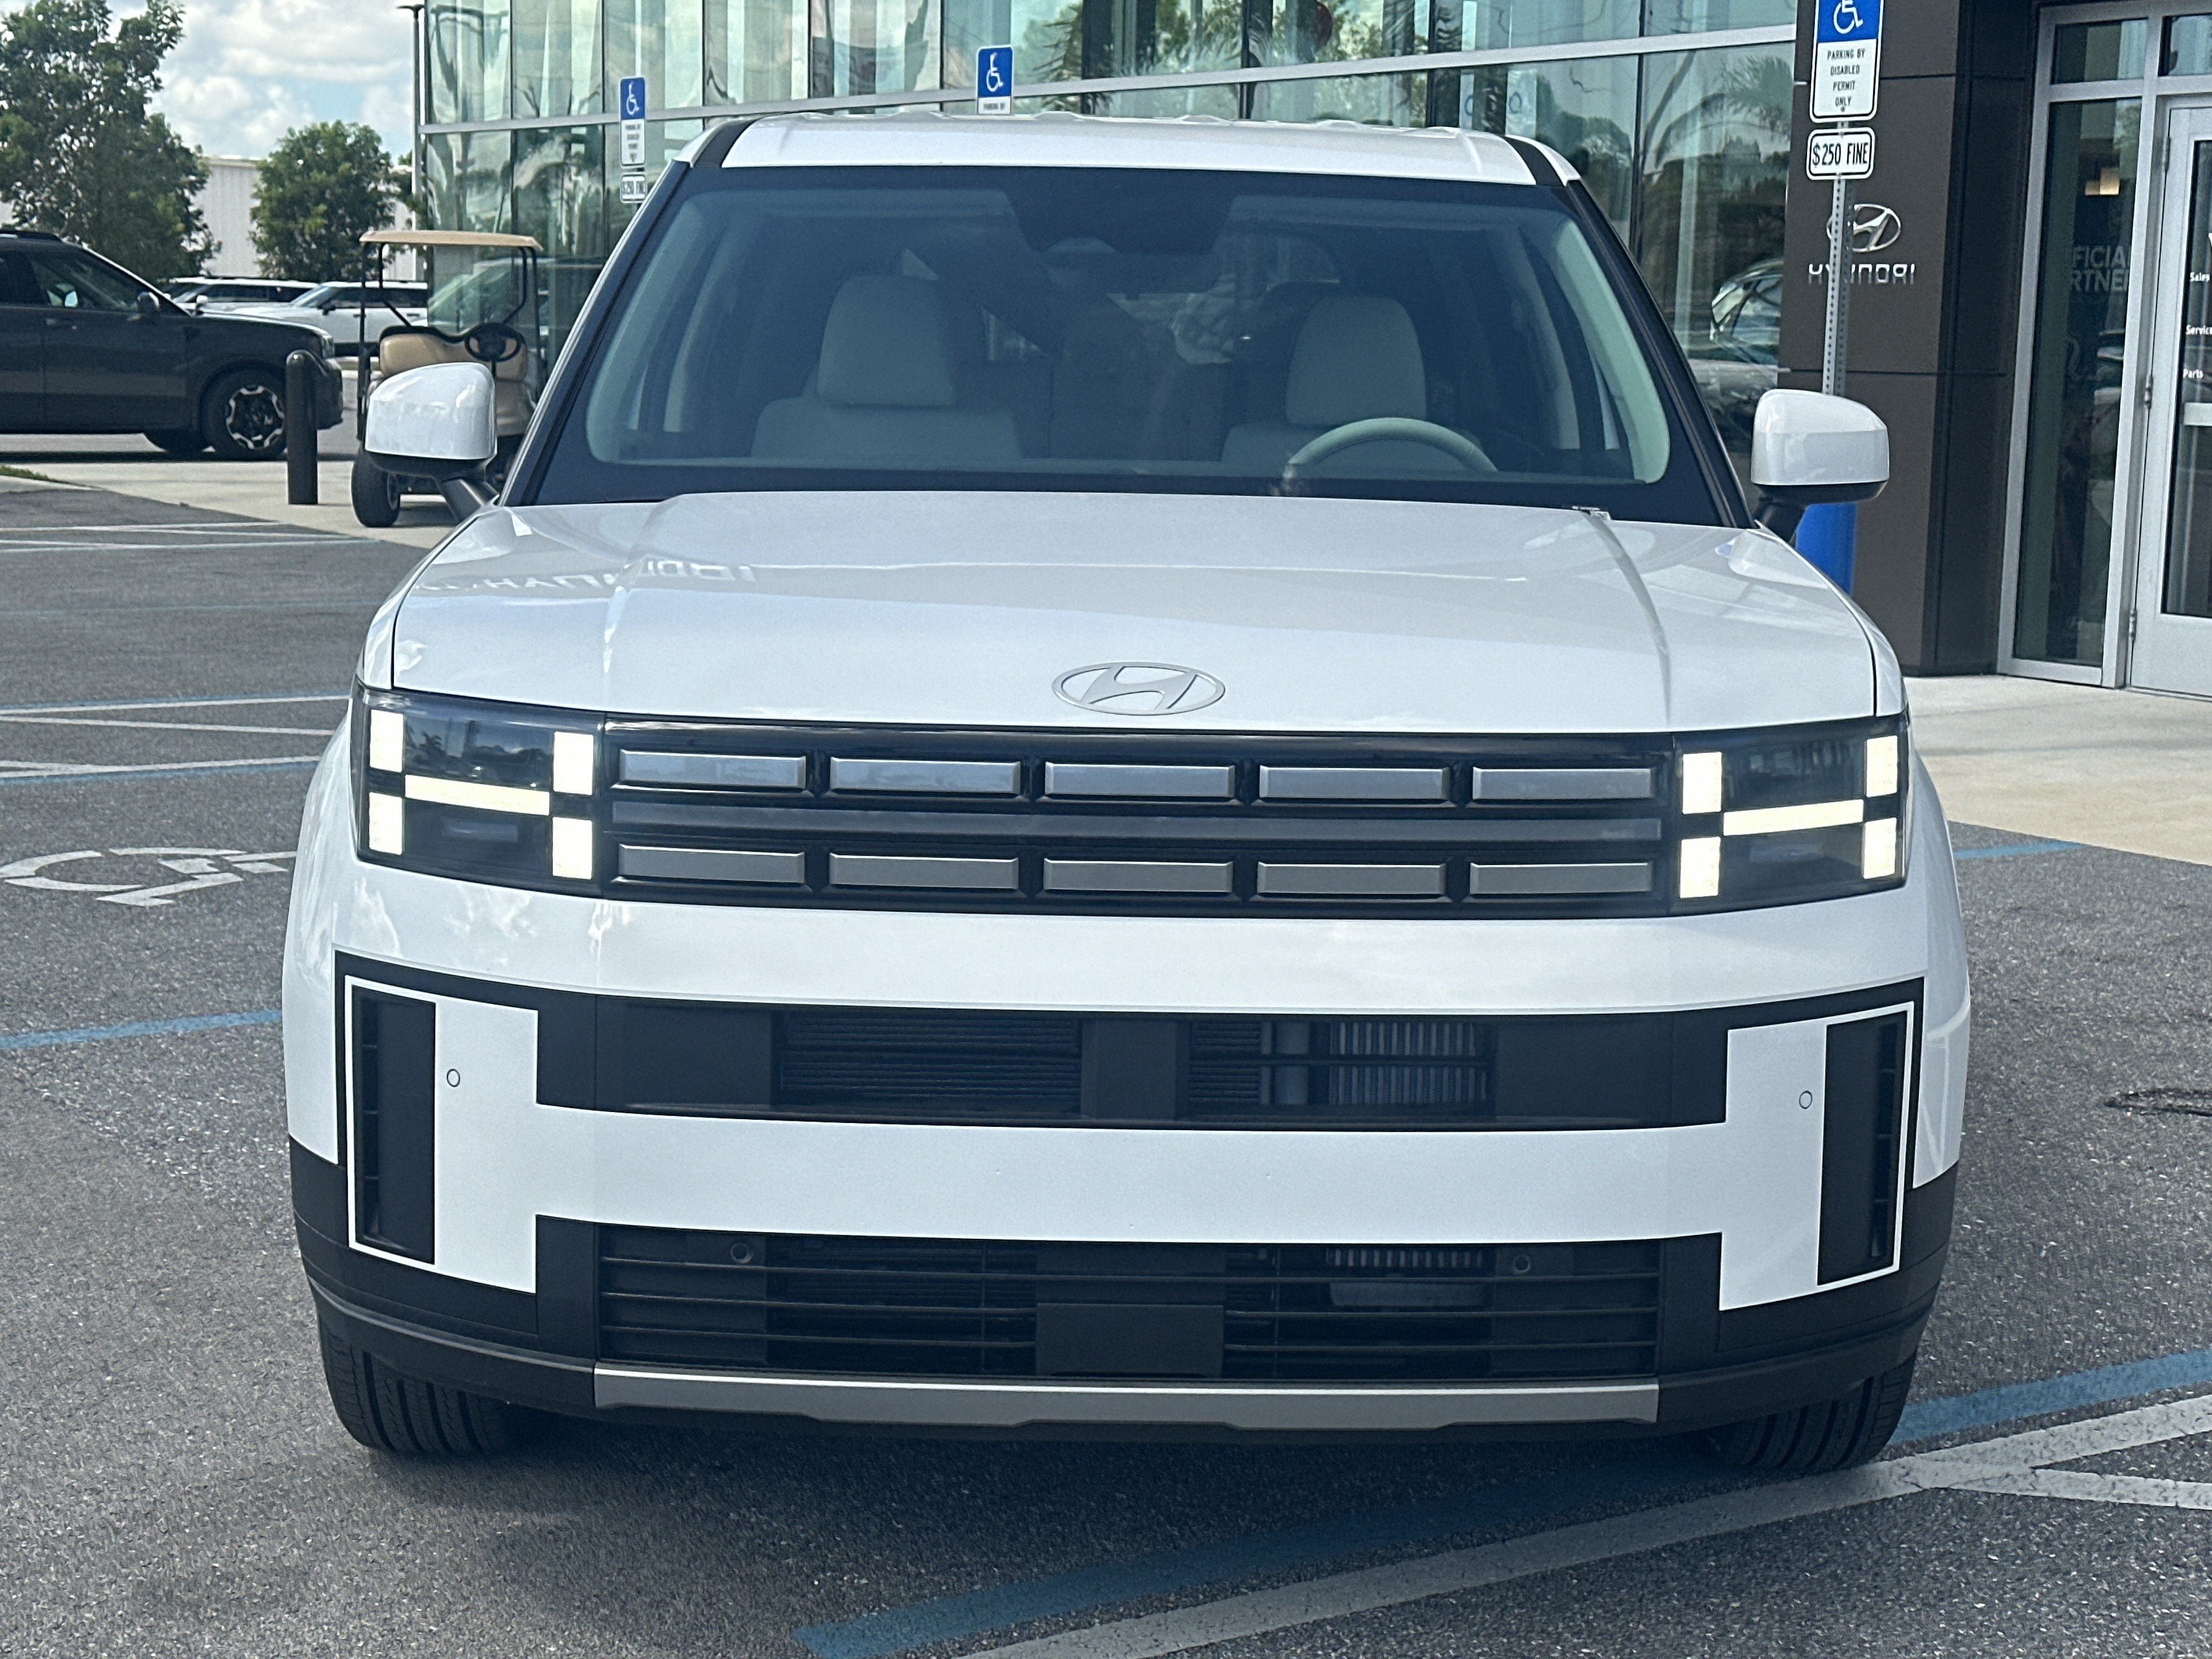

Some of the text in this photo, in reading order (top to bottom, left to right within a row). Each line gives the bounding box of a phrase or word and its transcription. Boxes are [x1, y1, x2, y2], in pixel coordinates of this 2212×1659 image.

[1827, 47, 1865, 61] PARKING BY
[1830, 64, 1860, 76] DISABLED
[1833, 80, 1855, 91] PERMIT
[1835, 96, 1852, 108] ONLY
[1812, 142, 1869, 168] $250 FINE
[1808, 263, 1915, 285] HNDAI
[2190, 272, 2210, 283] Sales
[2183, 368, 2203, 379] Parts
